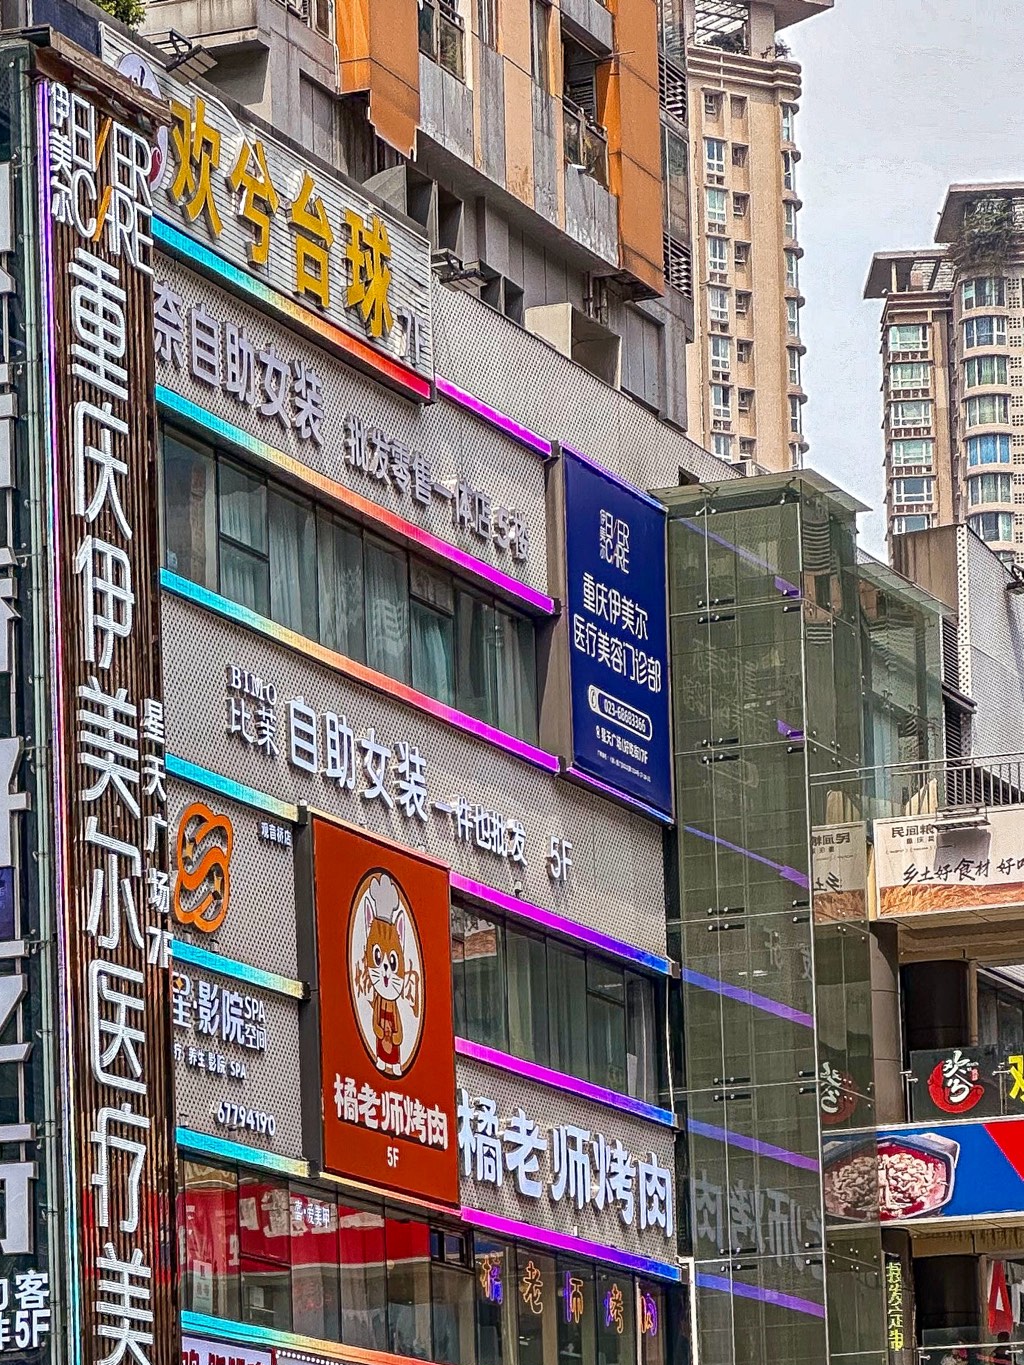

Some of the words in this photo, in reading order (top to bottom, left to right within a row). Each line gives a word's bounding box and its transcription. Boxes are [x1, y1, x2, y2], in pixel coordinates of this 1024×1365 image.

[169, 98, 395, 339] 欢兮台球
[397, 309, 431, 366] 7F
[582, 572, 649, 640] 重庆伊美尔
[574, 612, 662, 693] 医疗美容门诊部
[287, 696, 428, 821] 自助女装
[549, 836, 574, 882] 5F
[260, 820, 293, 848] 观音桥店
[245, 996, 267, 1023] SPA
[230, 1058, 247, 1079] SPA
[217, 1100, 277, 1137] 67794190
[333, 1073, 449, 1151] 橘老师烤肉
[386, 1146, 400, 1169] 5F
[458, 1086, 674, 1238] 橘老师烤肉
